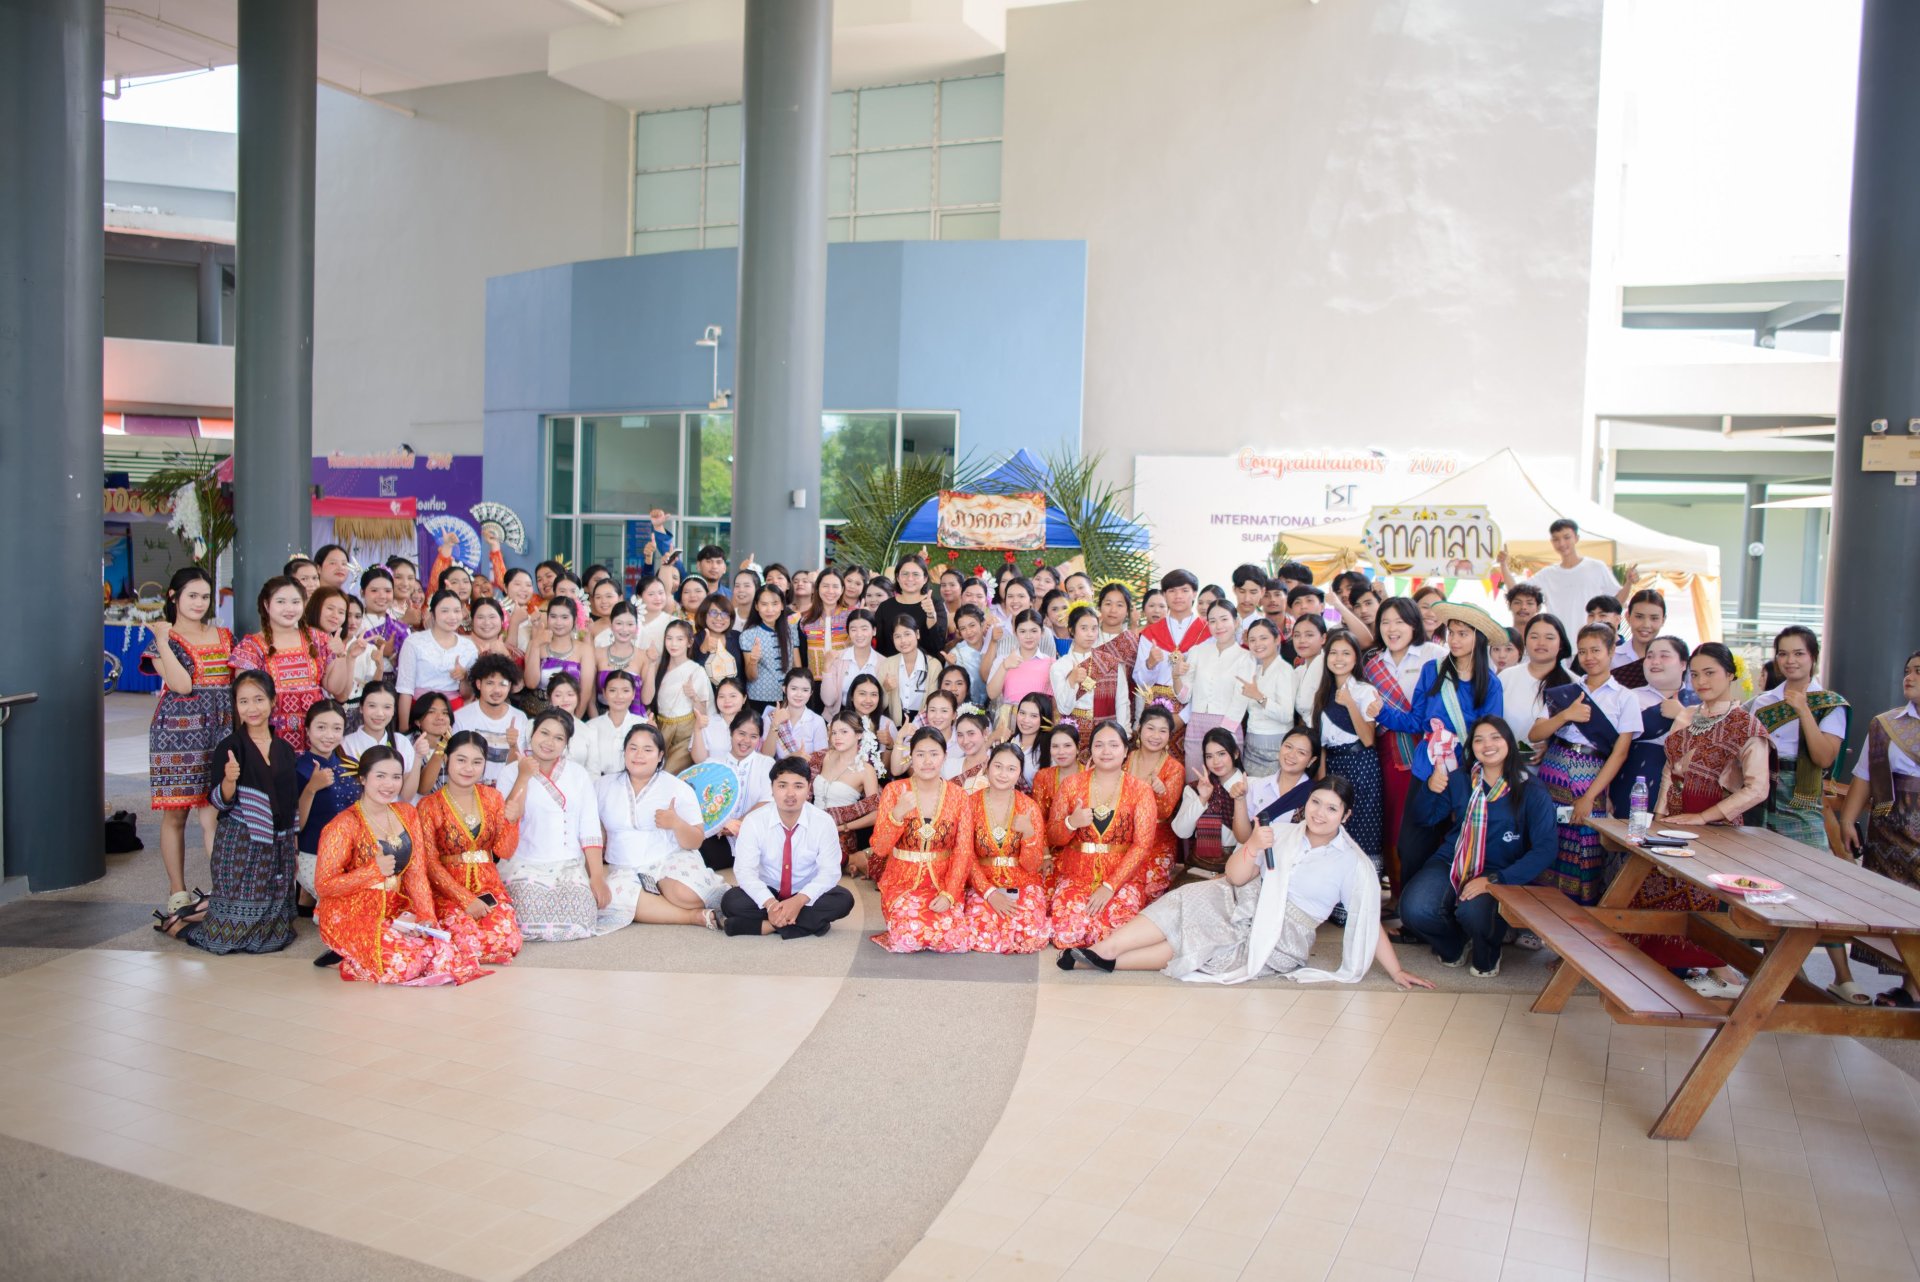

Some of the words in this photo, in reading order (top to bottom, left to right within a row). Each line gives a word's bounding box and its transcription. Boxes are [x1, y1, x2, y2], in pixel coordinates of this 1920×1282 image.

[416, 495, 447, 511] องเที่ยว
[951, 510, 1031, 528] ภาคกลาง
[1210, 514, 1317, 527] INTERNATIONAL
[1241, 533, 1279, 542] SURAT
[1376, 524, 1494, 558] ภาคกลาง
